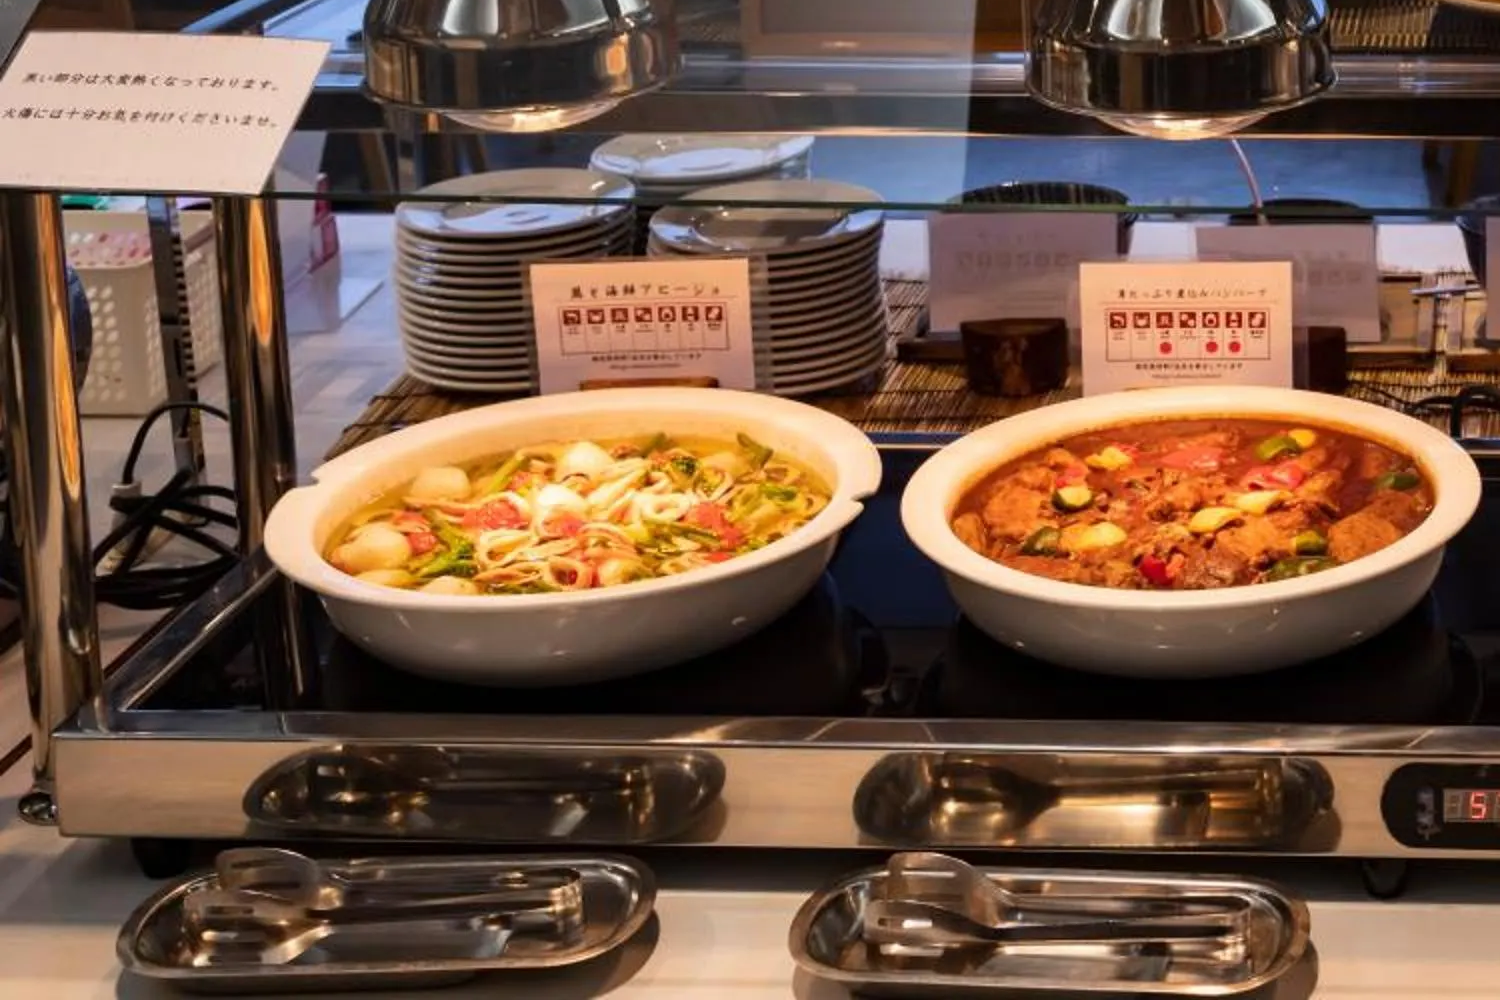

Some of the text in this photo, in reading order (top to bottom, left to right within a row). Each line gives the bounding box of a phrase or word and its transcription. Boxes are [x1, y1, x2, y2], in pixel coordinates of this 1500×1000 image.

[22, 71, 281, 92] 黒い部分は大変熱くなっております。
[1, 106, 279, 128] 火傷には十分お気を付けくださいませ。
